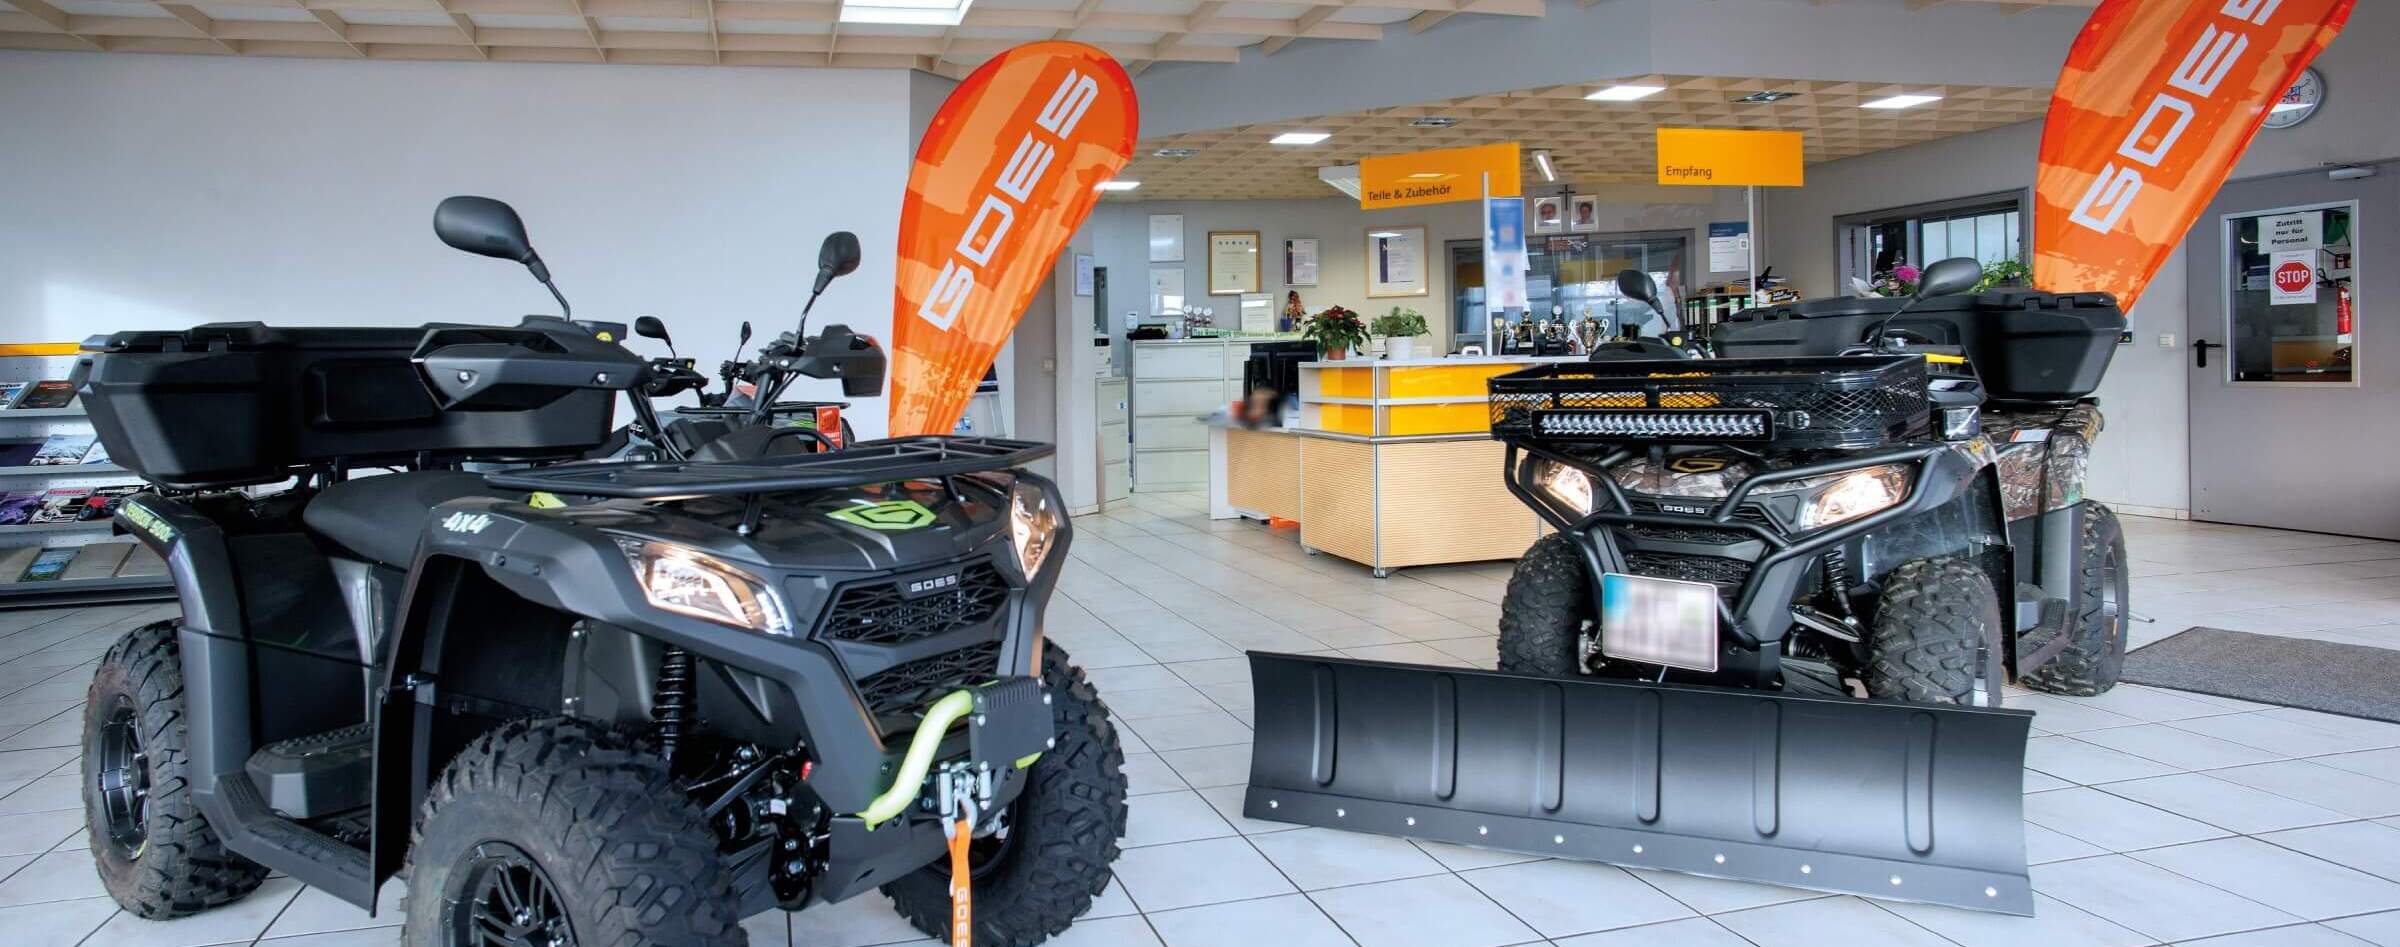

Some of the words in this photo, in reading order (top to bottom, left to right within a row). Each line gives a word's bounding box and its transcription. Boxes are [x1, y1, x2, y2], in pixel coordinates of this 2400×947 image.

[1666, 165, 1712, 180] Empfang
[1368, 190, 1391, 201] Teile
[1394, 188, 1402, 199] &
[1406, 183, 1451, 199] Zubehör
[917, 68, 1099, 332] GOES
[2275, 219, 2303, 228] Zutritt
[2271, 235, 2308, 245] Personal
[2278, 269, 2309, 284] STOP
[911, 575, 956, 592] GOES
